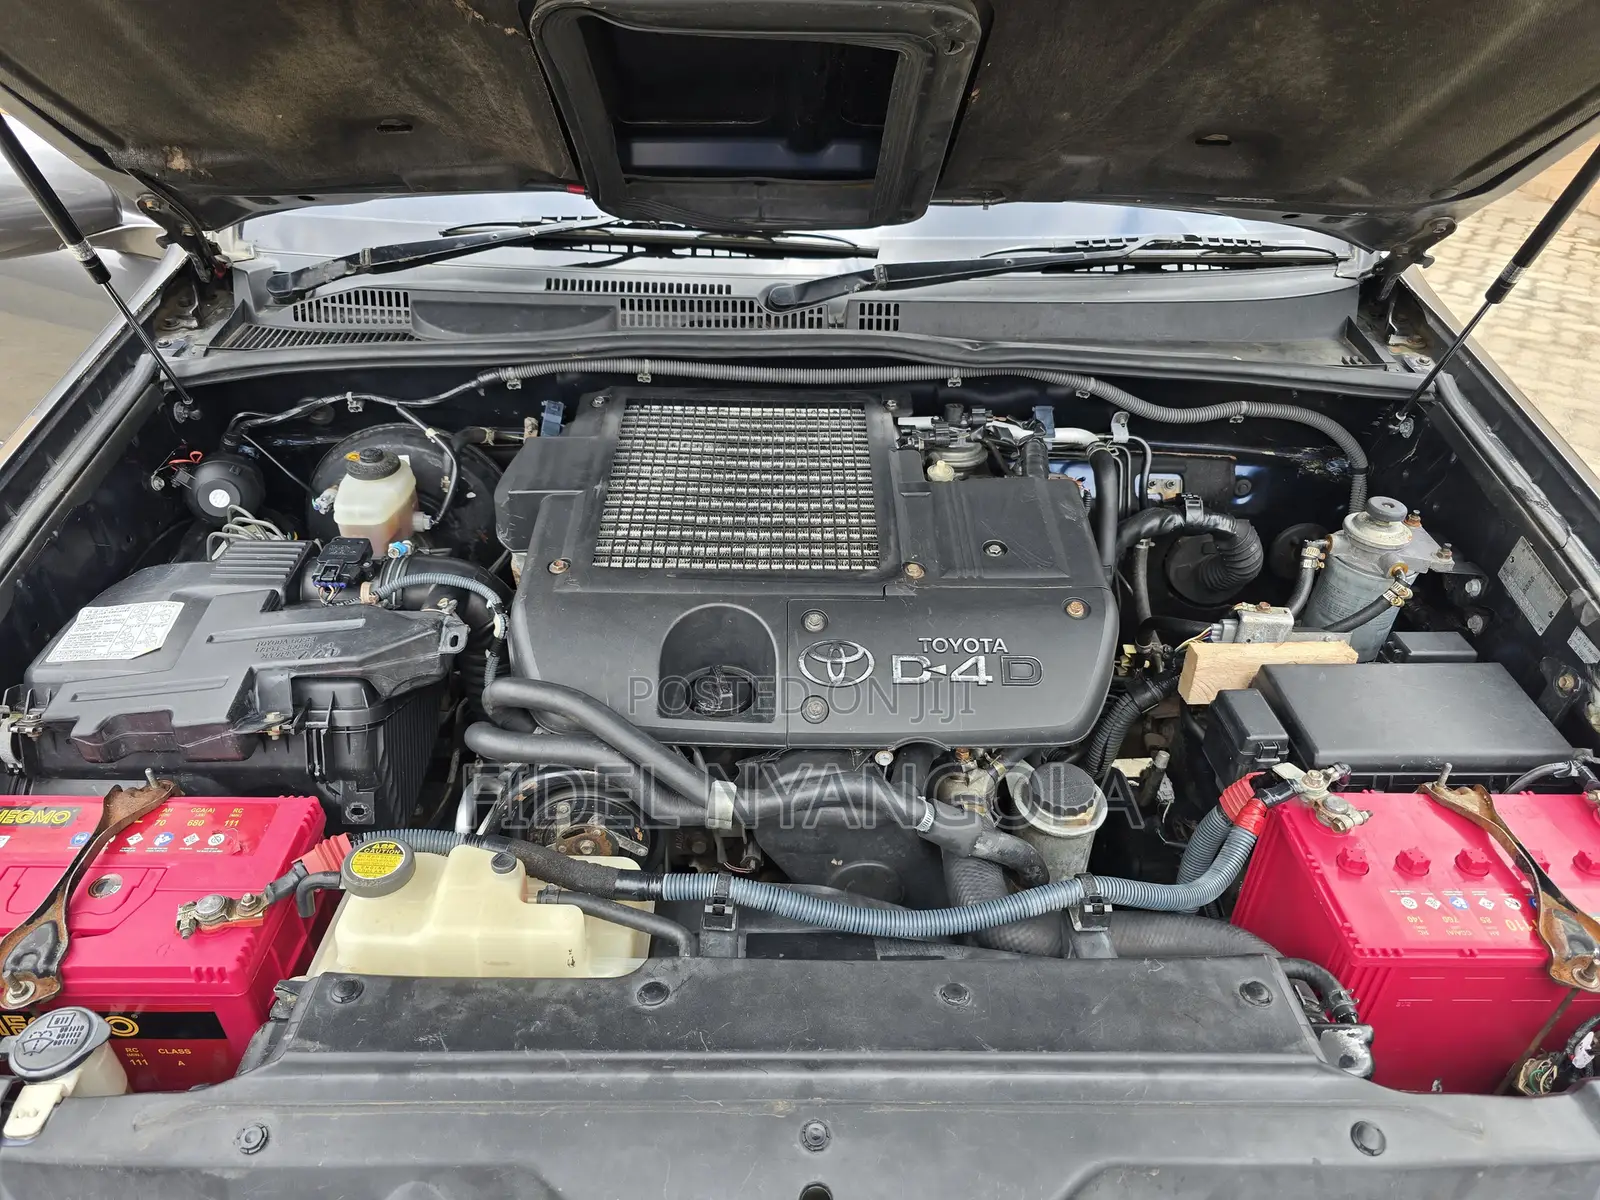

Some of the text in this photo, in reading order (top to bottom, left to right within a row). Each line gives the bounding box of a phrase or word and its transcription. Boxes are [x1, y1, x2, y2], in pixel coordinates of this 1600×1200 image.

[919, 637, 1009, 653] TOYOTA
[154, 819, 240, 827] 70 680 111
[158, 1047, 192, 1055] CLASS
[129, 1058, 149, 1066] 111
